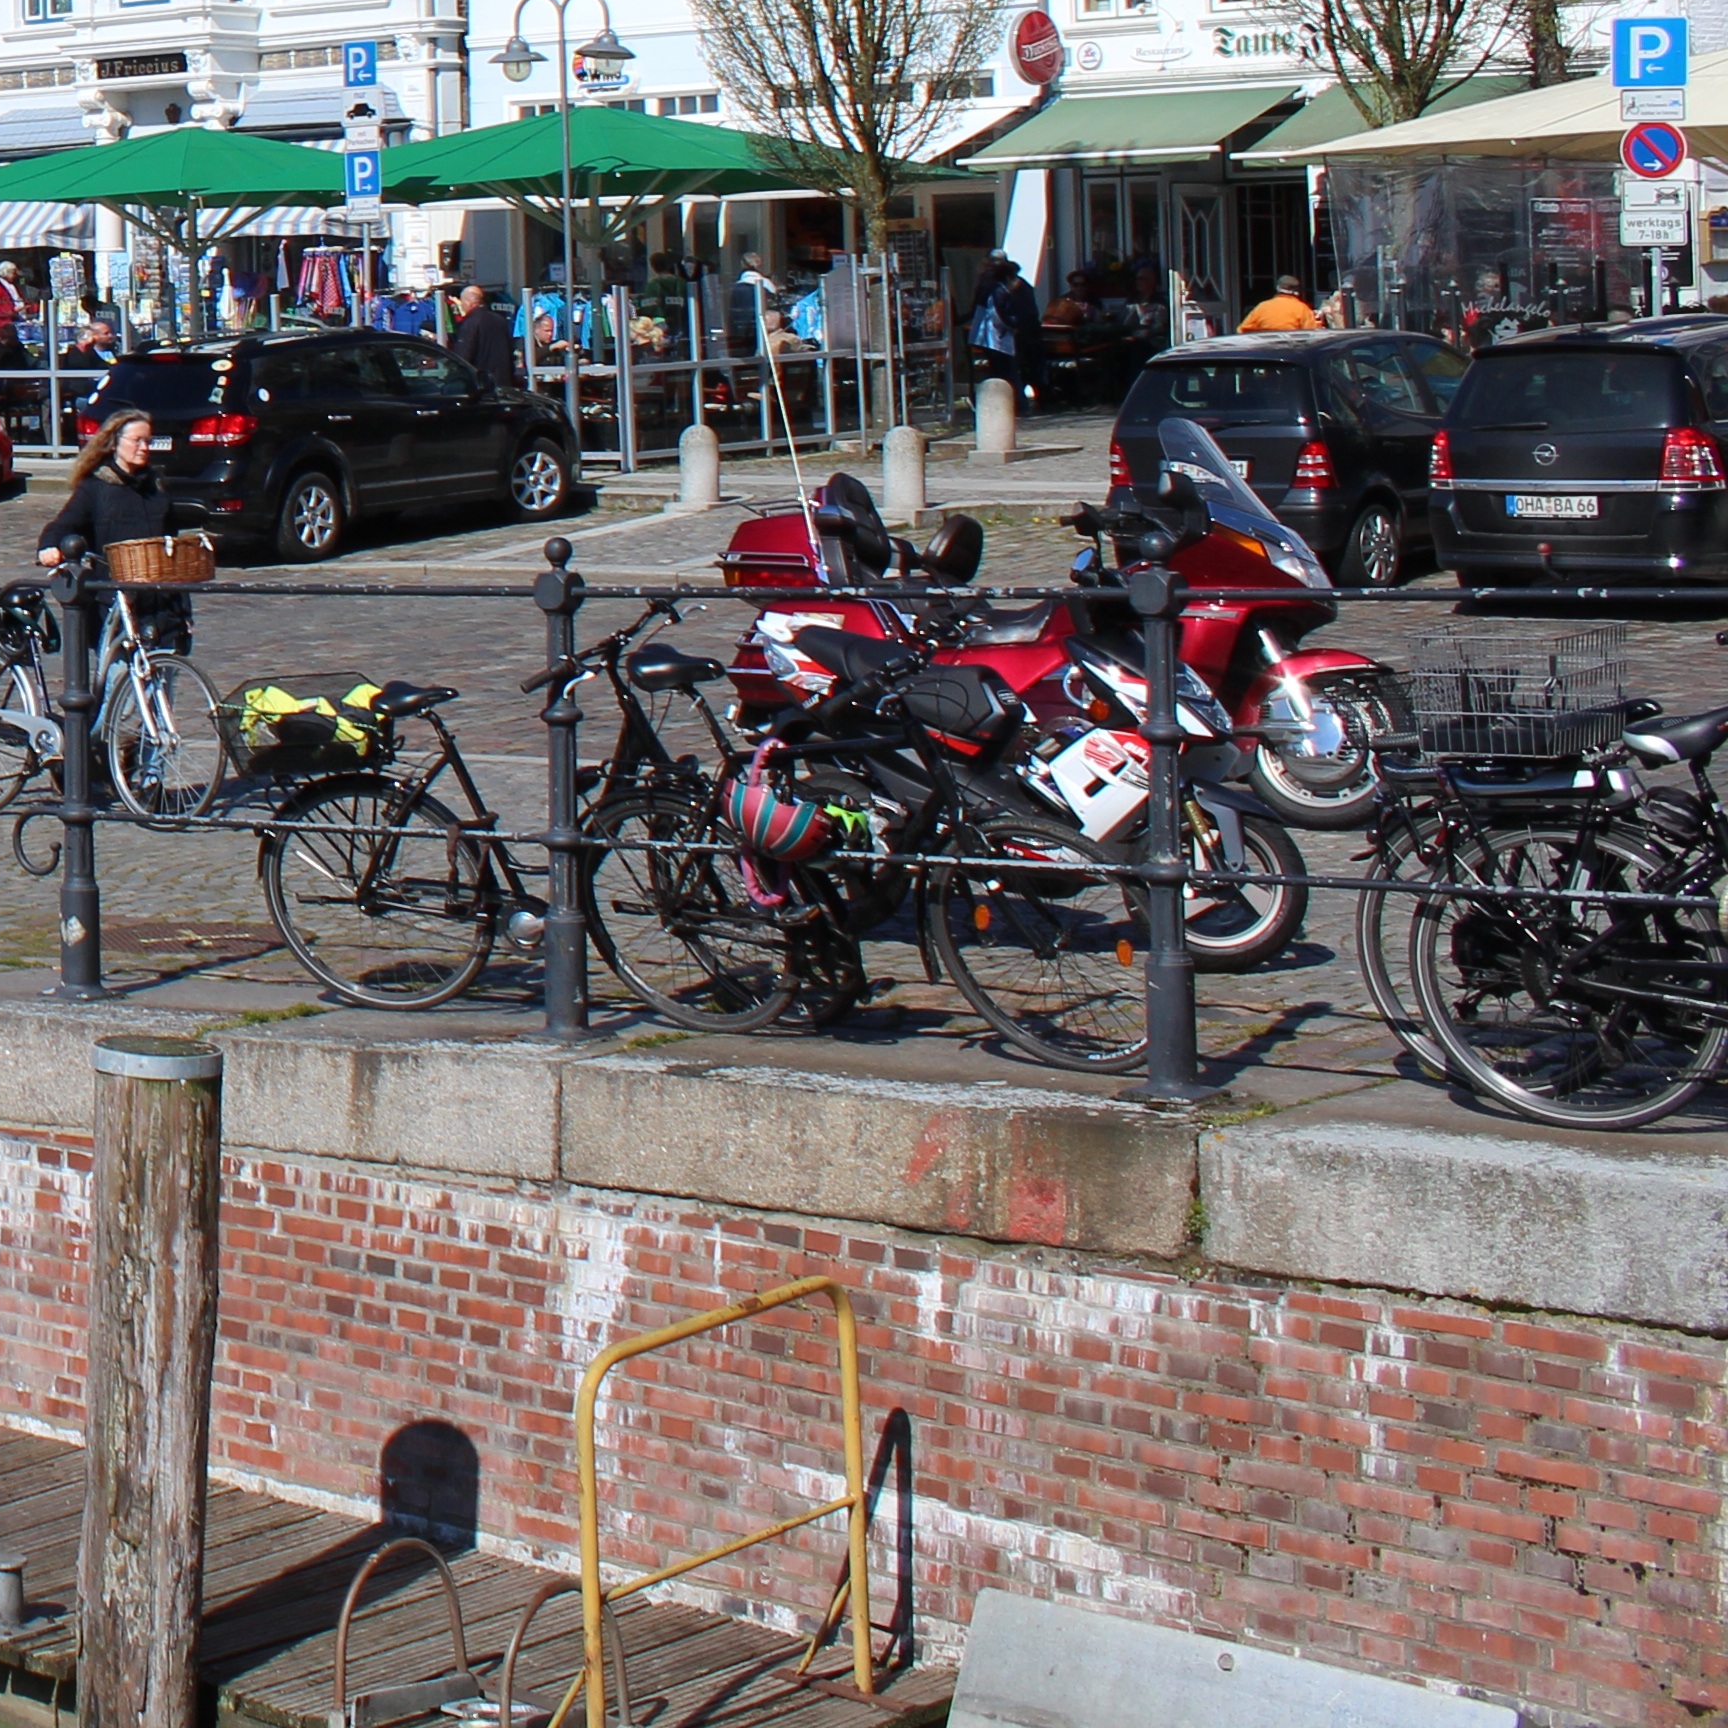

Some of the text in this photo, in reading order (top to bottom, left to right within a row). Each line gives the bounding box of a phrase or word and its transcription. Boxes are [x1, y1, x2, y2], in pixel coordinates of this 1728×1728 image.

[1136, 46, 1185, 57] Restaurant
[1213, 26, 1294, 58] Tante
[1629, 26, 1671, 80] P
[347, 47, 368, 83] P
[353, 156, 374, 193] P
[1626, 217, 1682, 231] werktags
[1461, 295, 1551, 319] Michelangelo
[1515, 498, 1596, 513] OHA BA 66
